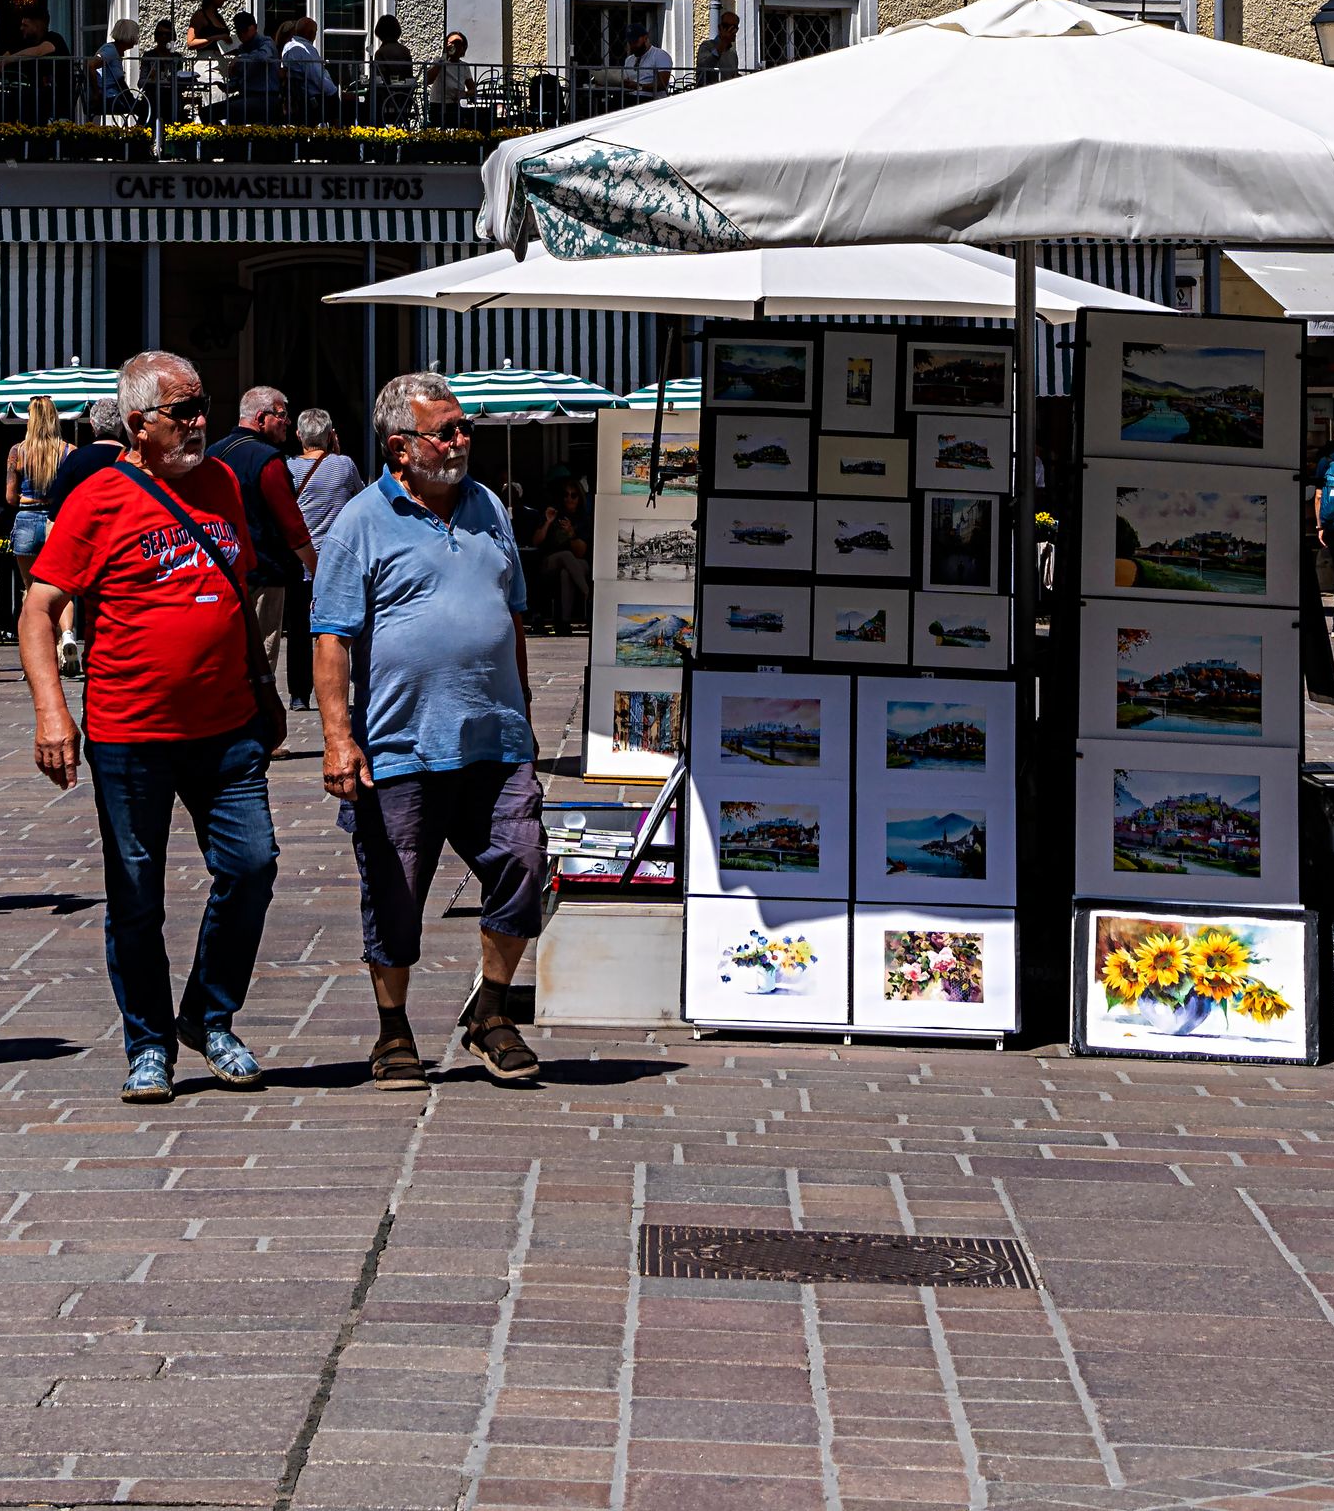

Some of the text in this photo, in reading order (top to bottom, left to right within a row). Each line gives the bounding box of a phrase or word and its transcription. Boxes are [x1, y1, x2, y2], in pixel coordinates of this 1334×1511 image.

[117, 176, 424, 201] CAFE TOMASELLI SEIT 1703
[139, 531, 169, 560] SEA
